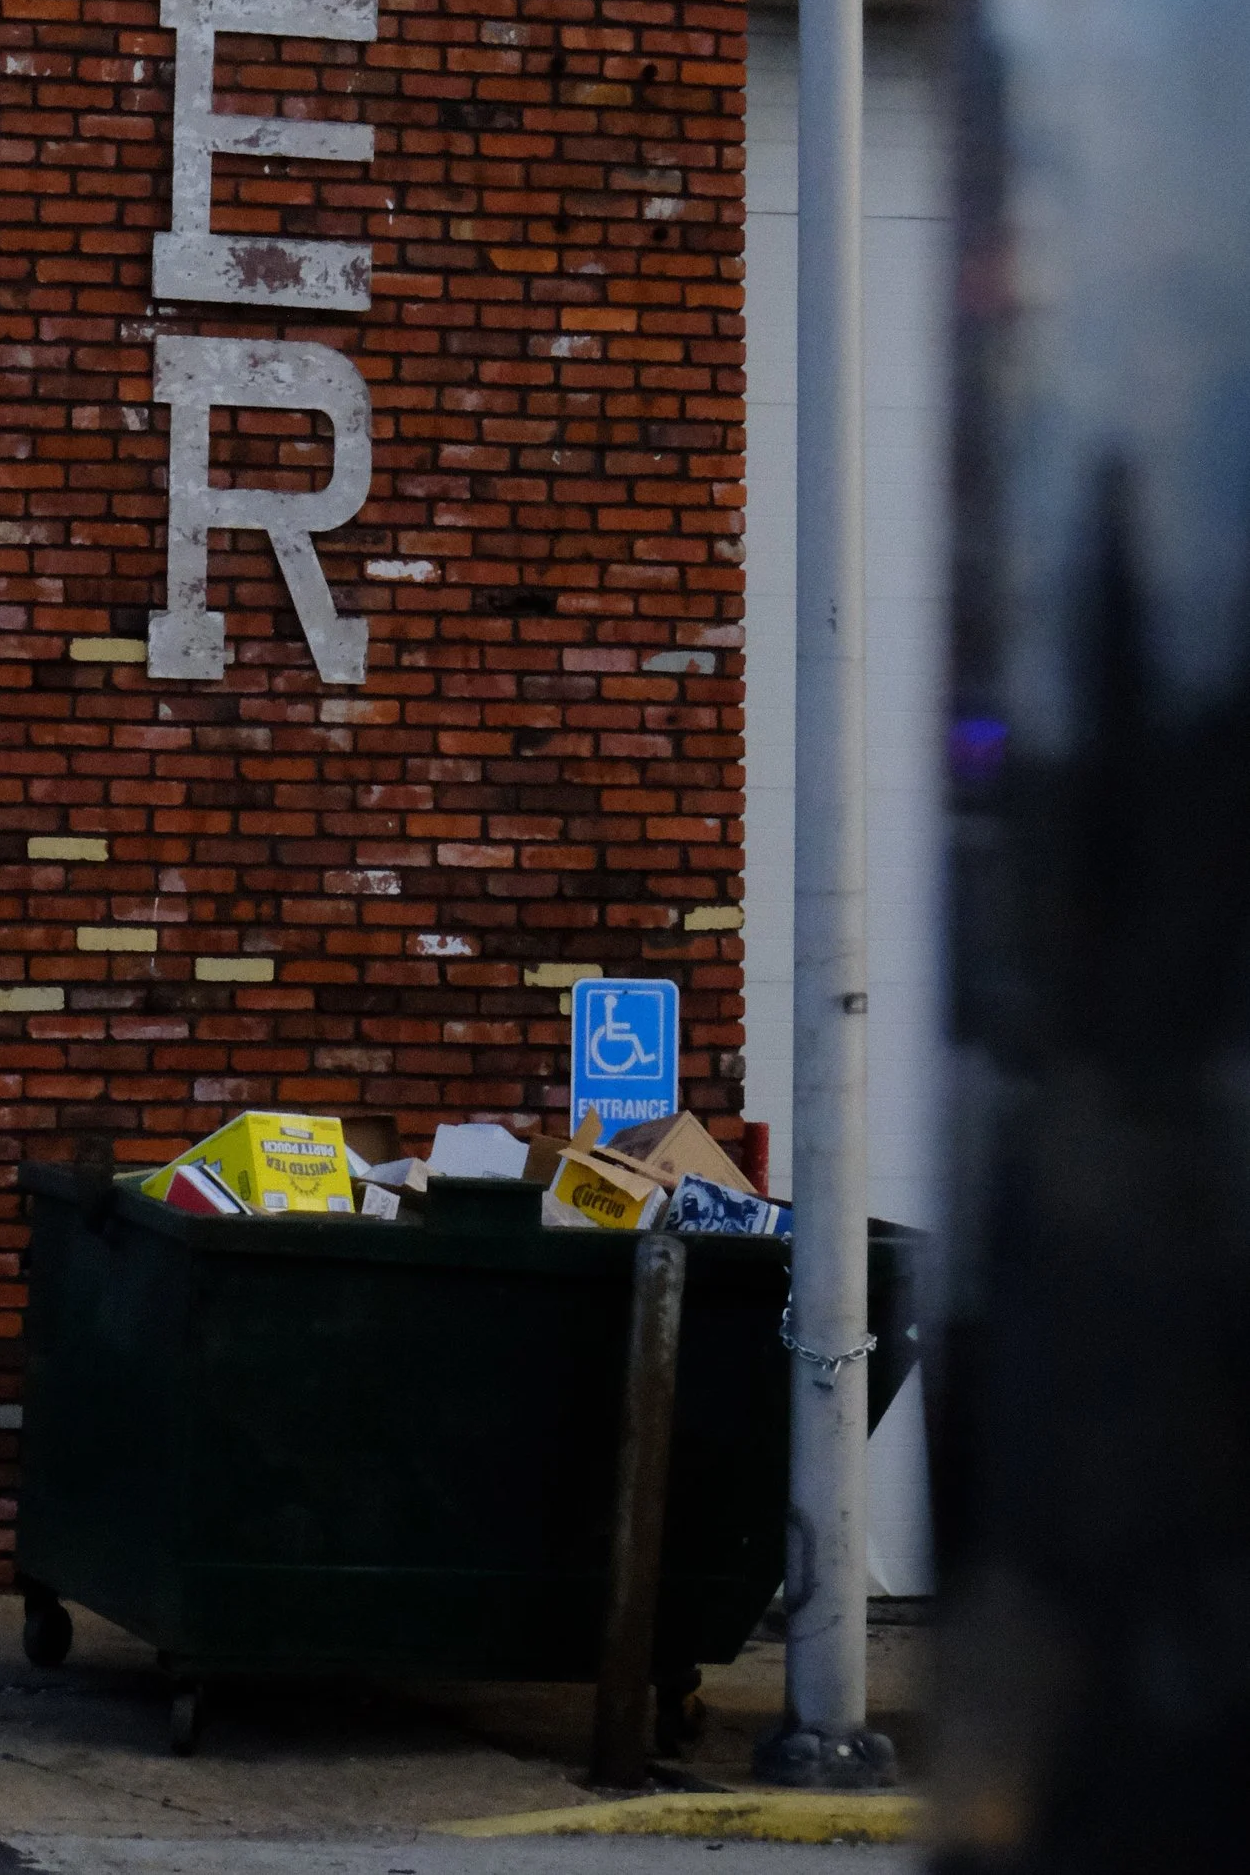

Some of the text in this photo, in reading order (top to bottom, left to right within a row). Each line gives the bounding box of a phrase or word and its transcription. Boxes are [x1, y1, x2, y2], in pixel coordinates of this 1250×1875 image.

[578, 1097, 669, 1120] ENTRANCE
[262, 1140, 336, 1158] PARTY POUCH
[266, 1155, 337, 1178] TWISTED TEA
[572, 1183, 626, 1219] Cuervo
